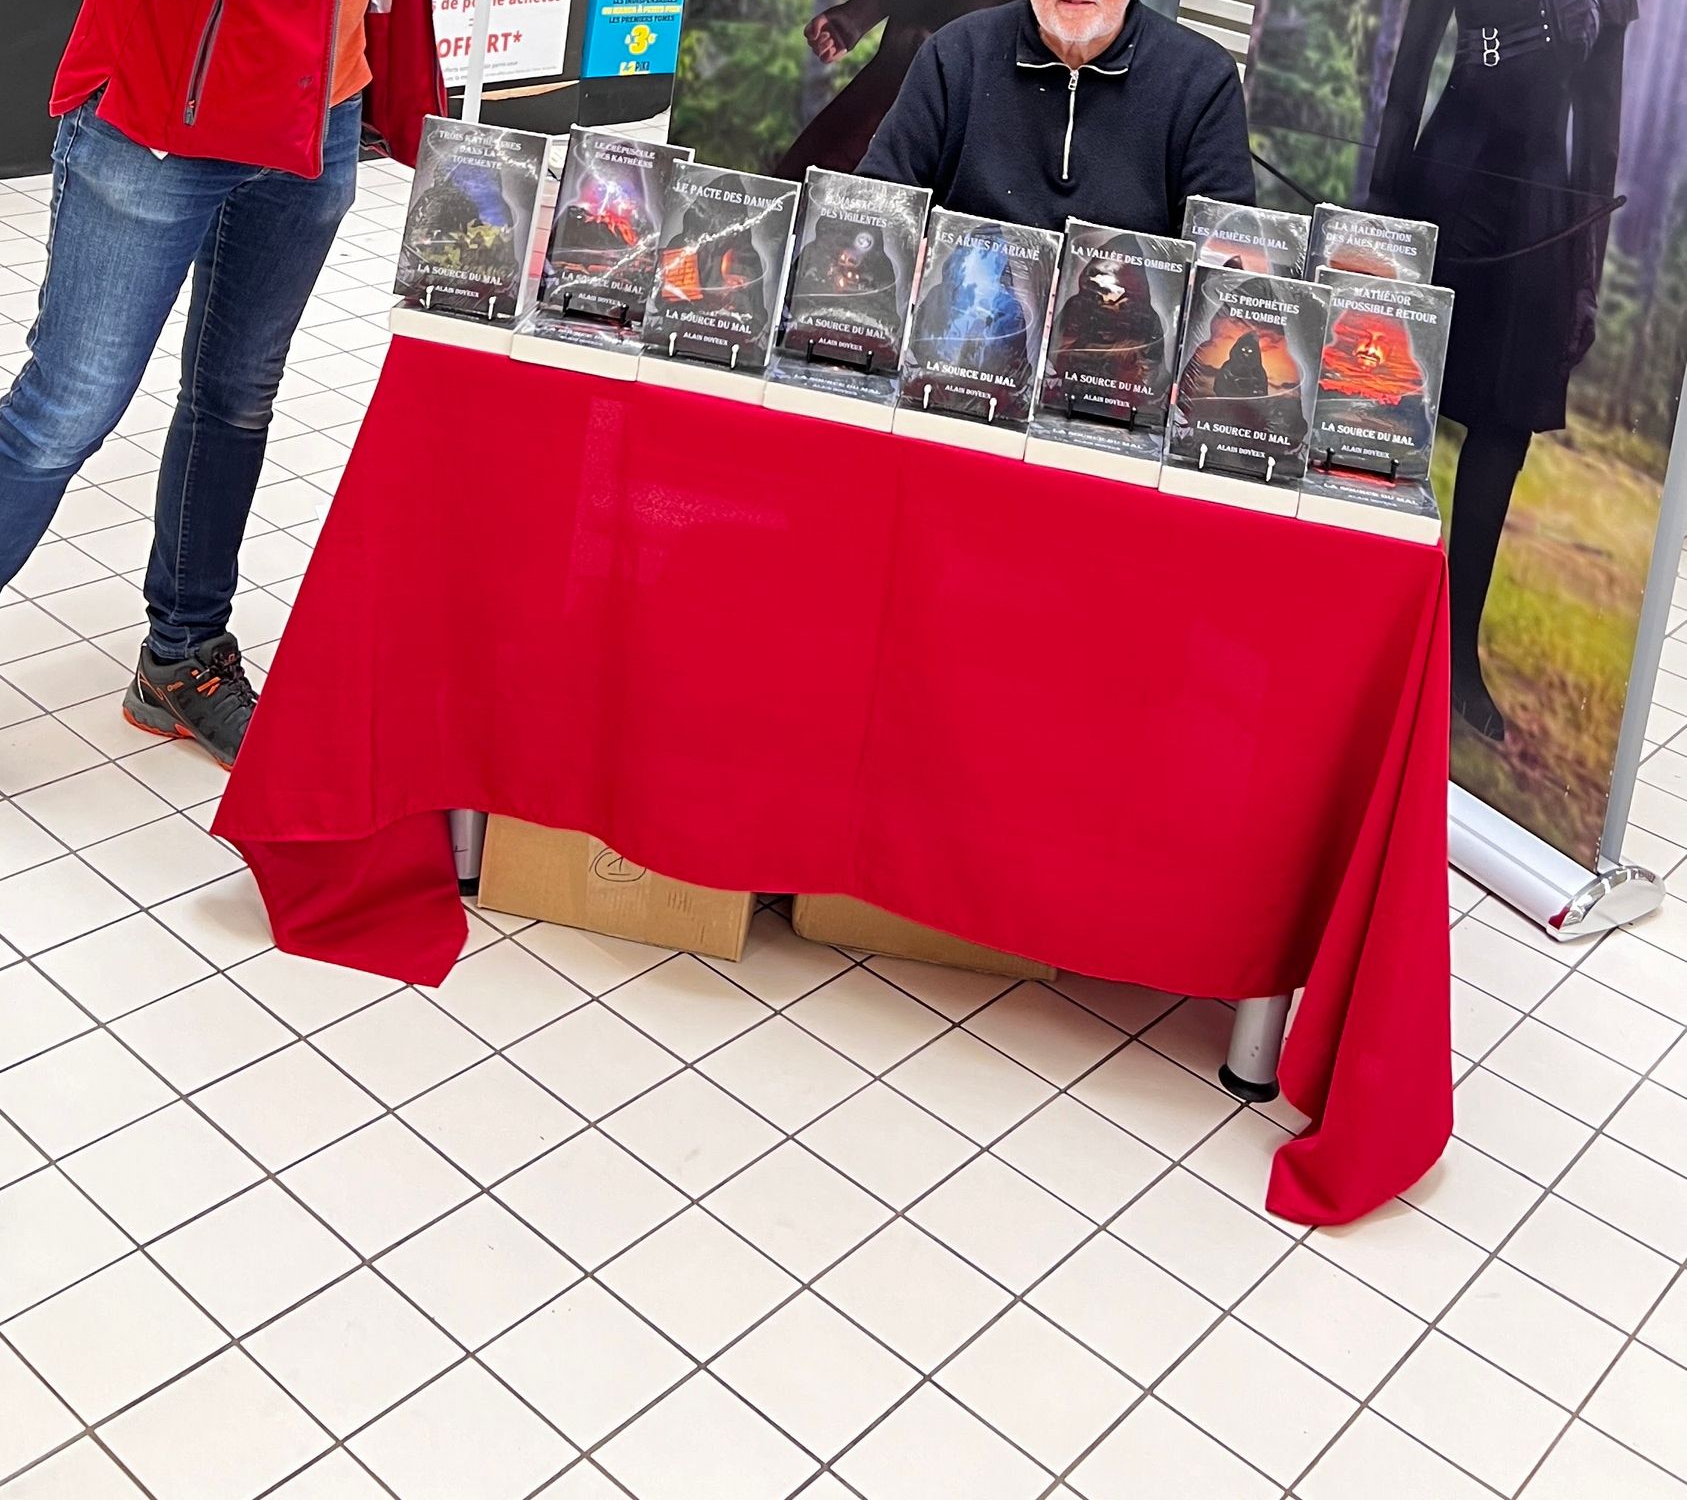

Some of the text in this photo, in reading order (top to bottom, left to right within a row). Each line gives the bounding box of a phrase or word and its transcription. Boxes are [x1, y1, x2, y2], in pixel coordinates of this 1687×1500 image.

[437, 30, 523, 59] OFFRT
[439, 130, 463, 141] TROIS
[594, 141, 606, 150] LE
[453, 155, 502, 170] TOURMENTE
[484, 147, 496, 157] LA
[690, 184, 721, 200] PACTE
[723, 191, 743, 204] DES
[820, 207, 837, 219] DES
[1192, 225, 1289, 251] LES ARMÉES DU MAL
[1334, 221, 1412, 243] LA MALÉDICTION
[936, 231, 1040, 261] LES ARMES D'ARIANE
[1326, 232, 1345, 243] DES
[1374, 241, 1418, 257] PERDUES
[1071, 244, 1183, 273] LA VALLÉE DES OMBRES
[417, 263, 503, 285] LA SOURCE DU MAL
[562, 271, 574, 281] LA
[611, 281, 624, 291] DU
[625, 283, 644, 294] MAL
[1220, 291, 1300, 315] LES PROPHÉTIES
[1354, 287, 1411, 306] MATHÉNOR
[665, 309, 752, 334] LA SOURCE DU MAL
[1230, 307, 1288, 326] DE L'OMBRE
[1333, 297, 1437, 325] IMPOSSIBLE RETOUR
[800, 316, 886, 340] LA SOURCE DU MAL
[927, 361, 1016, 388] LA SOURCE DU MAL
[1065, 371, 1154, 396] LA SOURCE DU MAL
[1196, 420, 1291, 446] LA SOURCE DU MAL
[1321, 421, 1415, 446] LA SOURCE DU MAL
